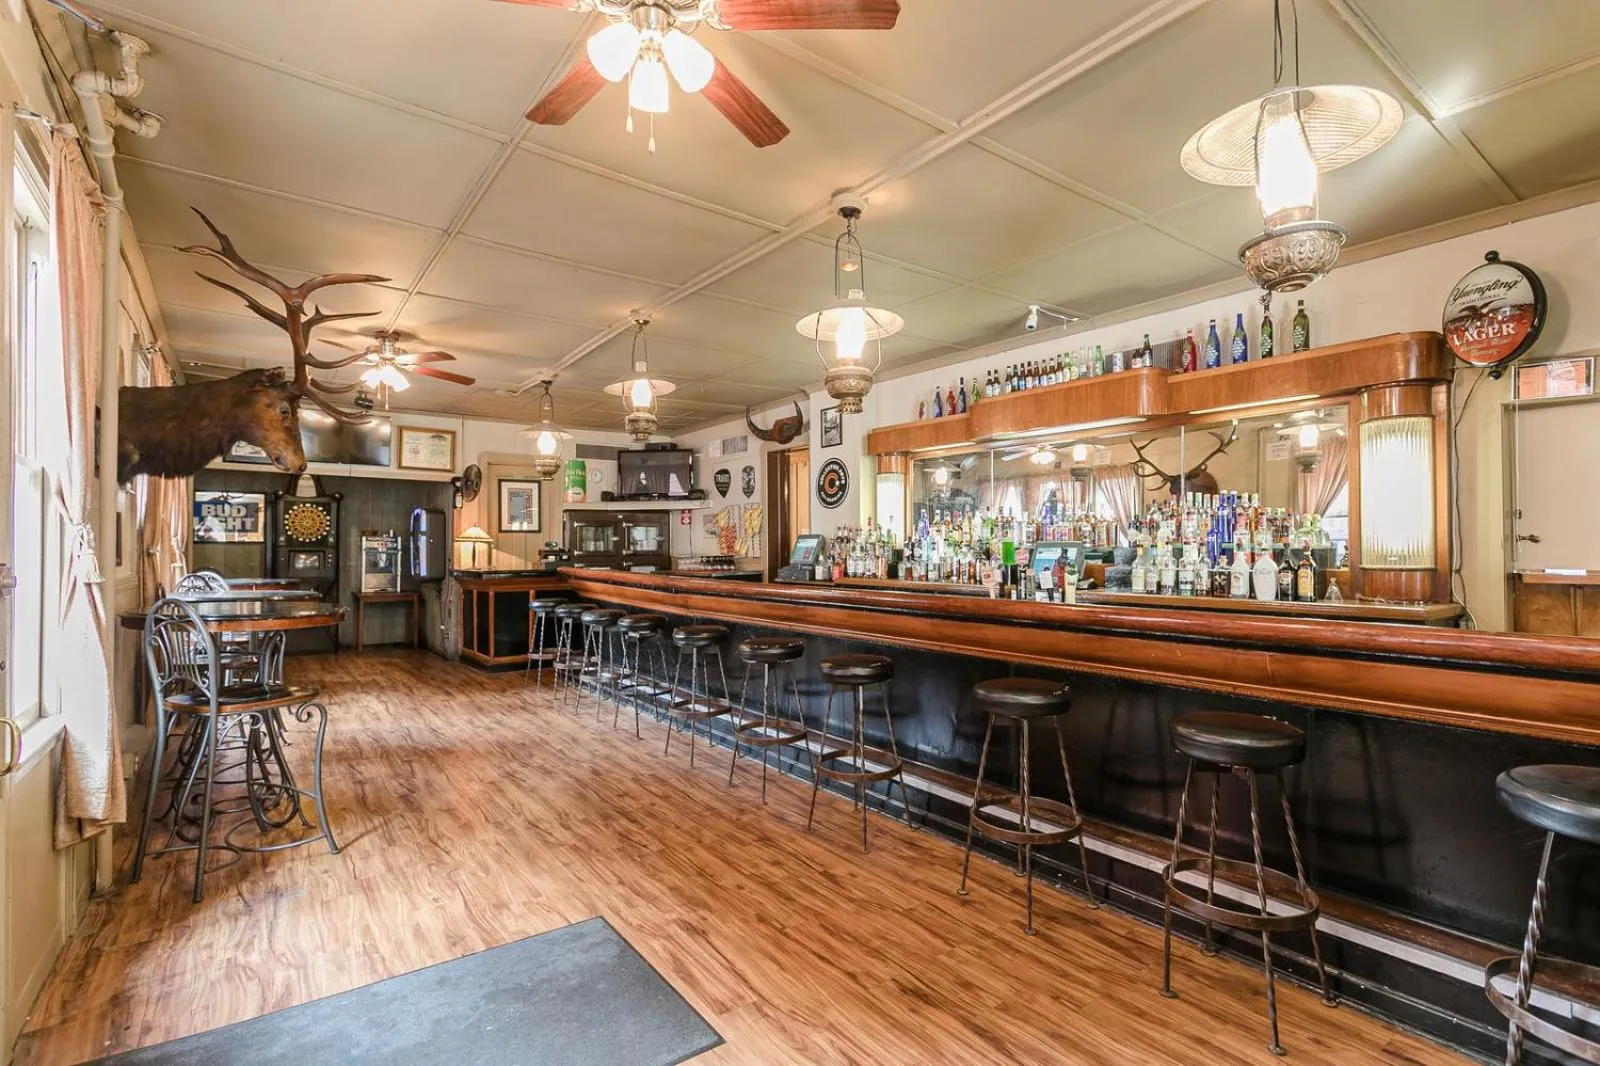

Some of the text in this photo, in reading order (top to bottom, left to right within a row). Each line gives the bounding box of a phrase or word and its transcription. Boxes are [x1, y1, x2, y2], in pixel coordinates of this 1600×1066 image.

[1452, 276, 1524, 304] Yuengling
[1453, 323, 1516, 346] LAGER
[201, 504, 247, 518] BUD
[193, 516, 256, 531] LGHT
